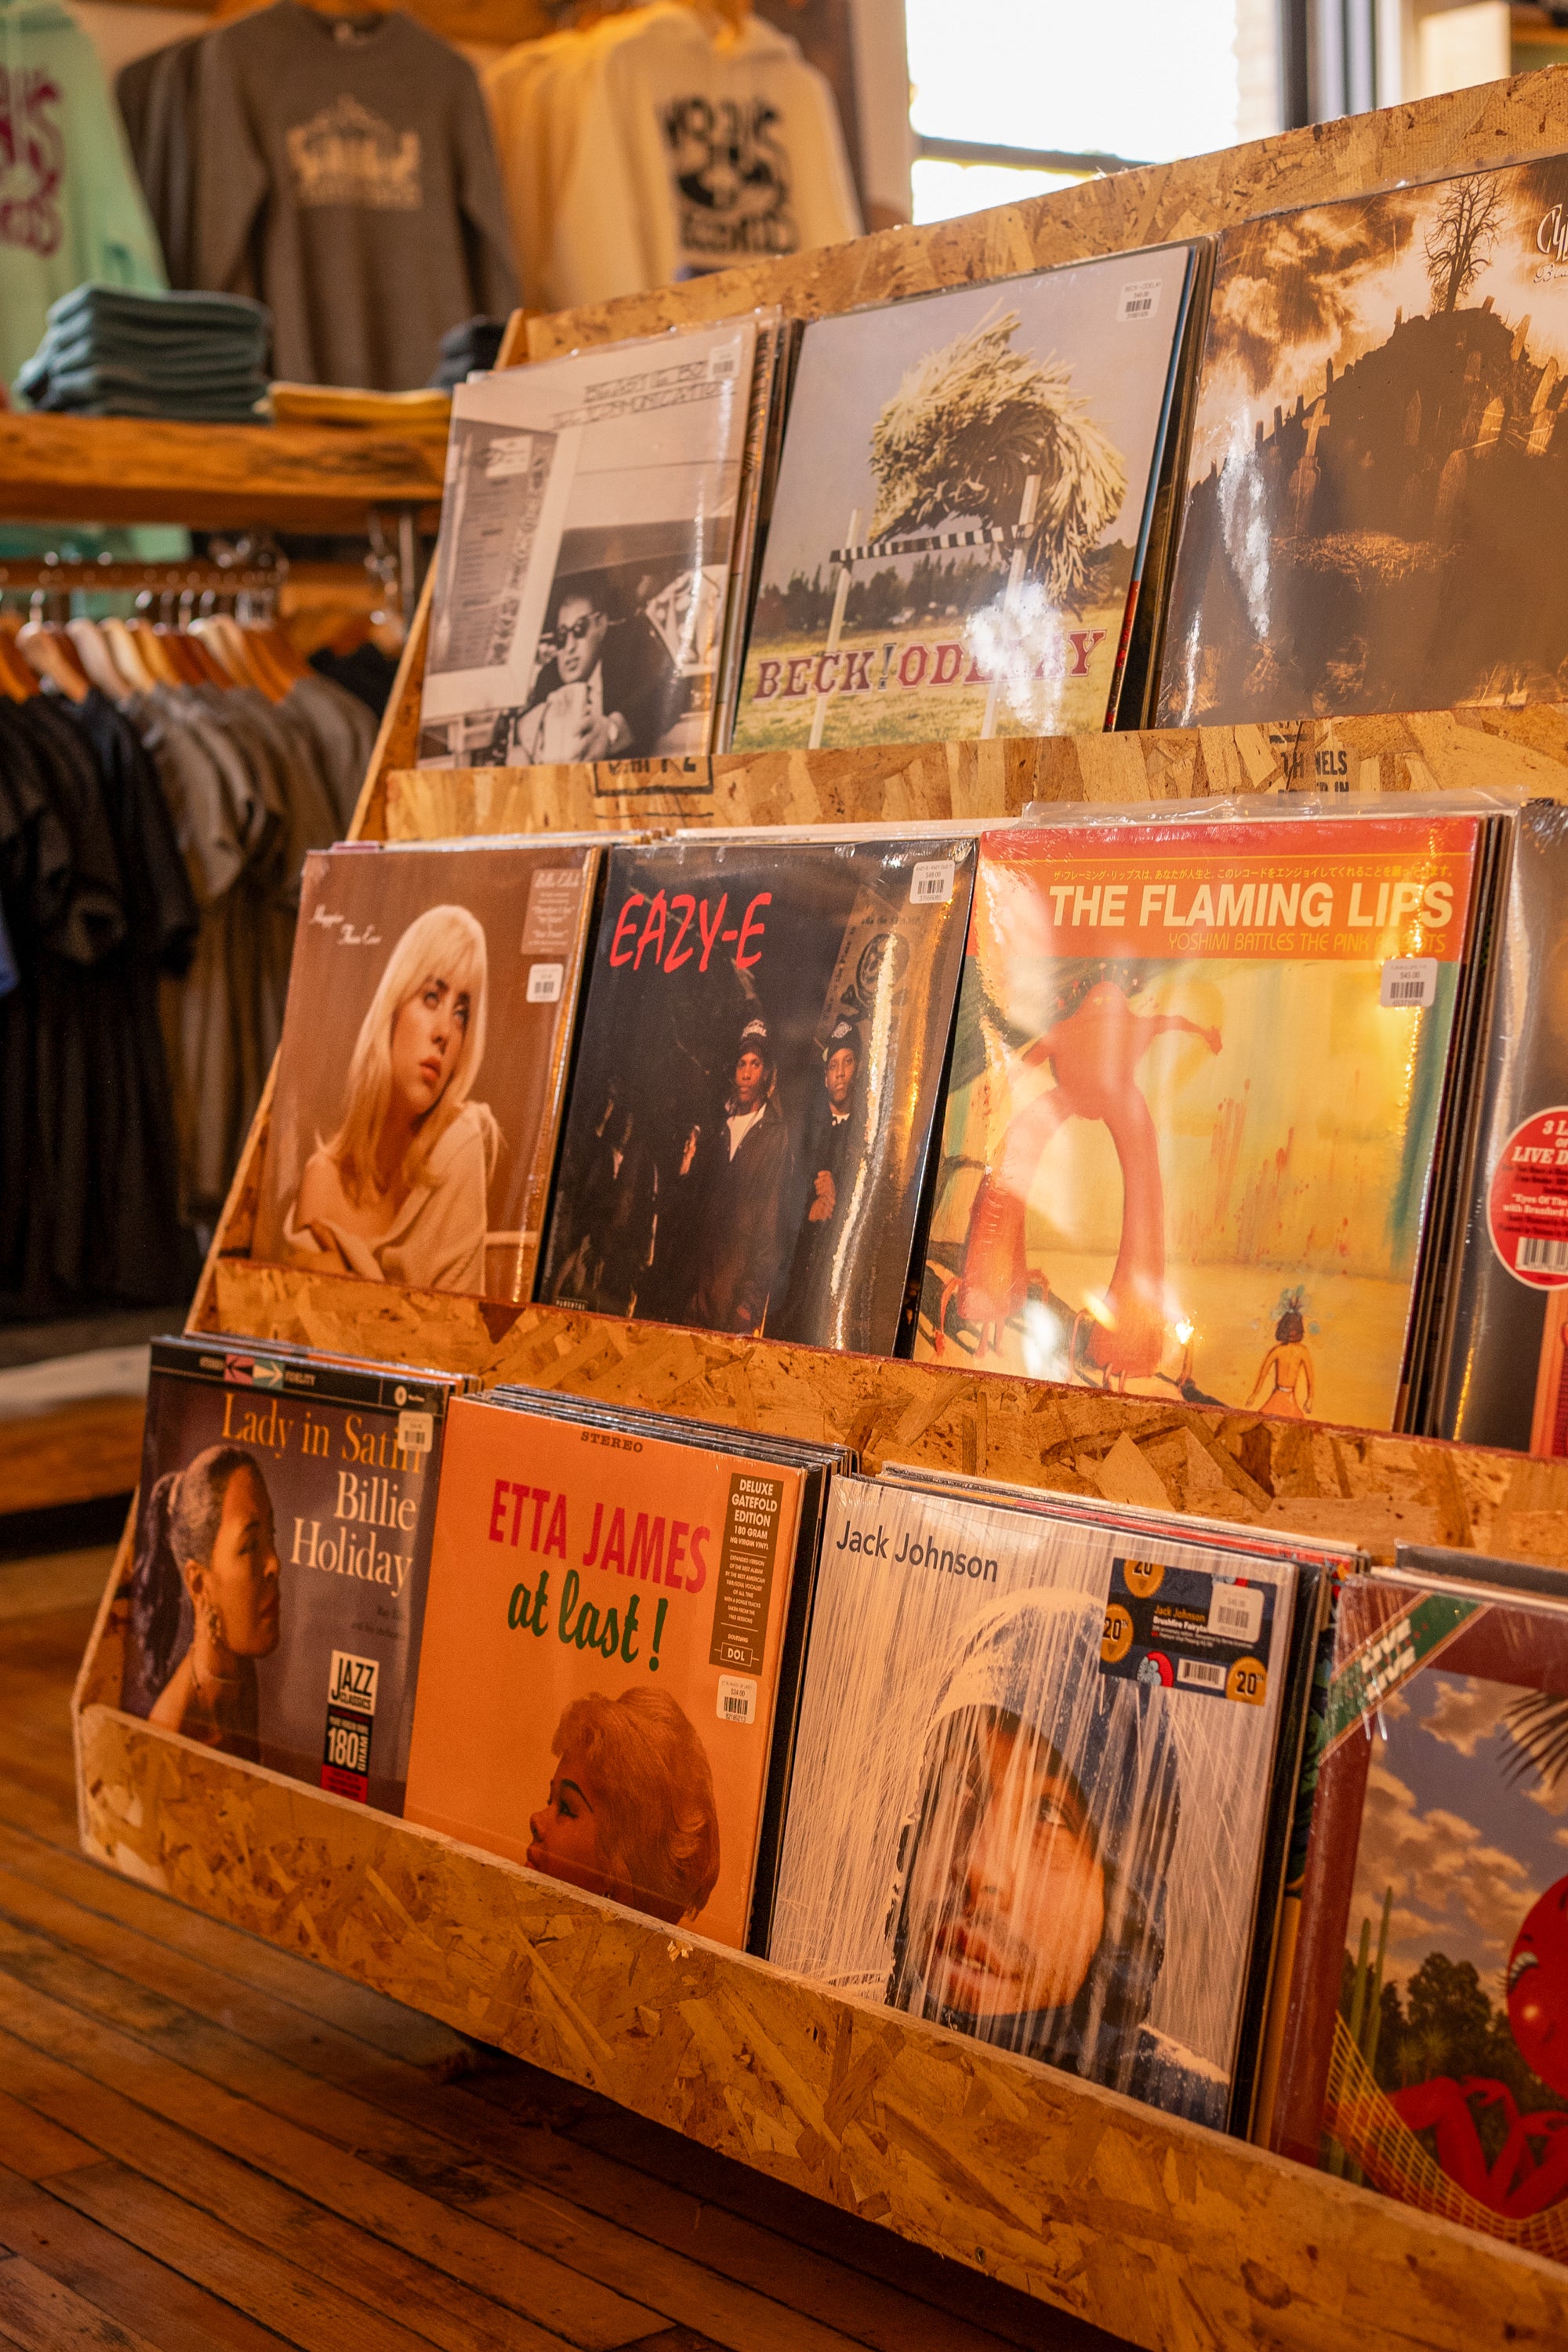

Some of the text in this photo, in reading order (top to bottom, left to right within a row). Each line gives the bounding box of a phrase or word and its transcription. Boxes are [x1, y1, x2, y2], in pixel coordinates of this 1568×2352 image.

[1049, 881, 1454, 928] THE FLAMING LIPS
[610, 889, 772, 973] EAZY-E
[1168, 932, 1229, 951] YOSHIMI
[1234, 932, 1295, 951] BATTLES
[1300, 932, 1329, 951] THE
[1334, 933, 1370, 952] PINK
[1542, 1120, 1555, 1135] 3
[1512, 1146, 1555, 1164] LIVE
[222, 1392, 295, 1459] Lady
[301, 1412, 330, 1457] in
[581, 1431, 644, 1454] STEREO
[739, 1479, 774, 1497] DELUXE
[334, 1471, 416, 1531] Billie
[731, 1494, 778, 1512] GATEFOLD
[734, 1509, 771, 1527] EDITION
[488, 1479, 711, 1595] ETTA JAMES
[734, 1525, 768, 1540] 180 GRAM
[739, 1537, 755, 1548] VIRGIN
[755, 1541, 769, 1550] VINYL
[291, 1518, 413, 1597] Holiday
[837, 1520, 998, 1582] Jack Johnson
[508, 1570, 550, 1637] at
[1154, 1605, 1206, 1622] Jack Johnson
[728, 1647, 745, 1661] DOL
[332, 1657, 375, 1700] JAZZ
[328, 1727, 359, 1769] 180
